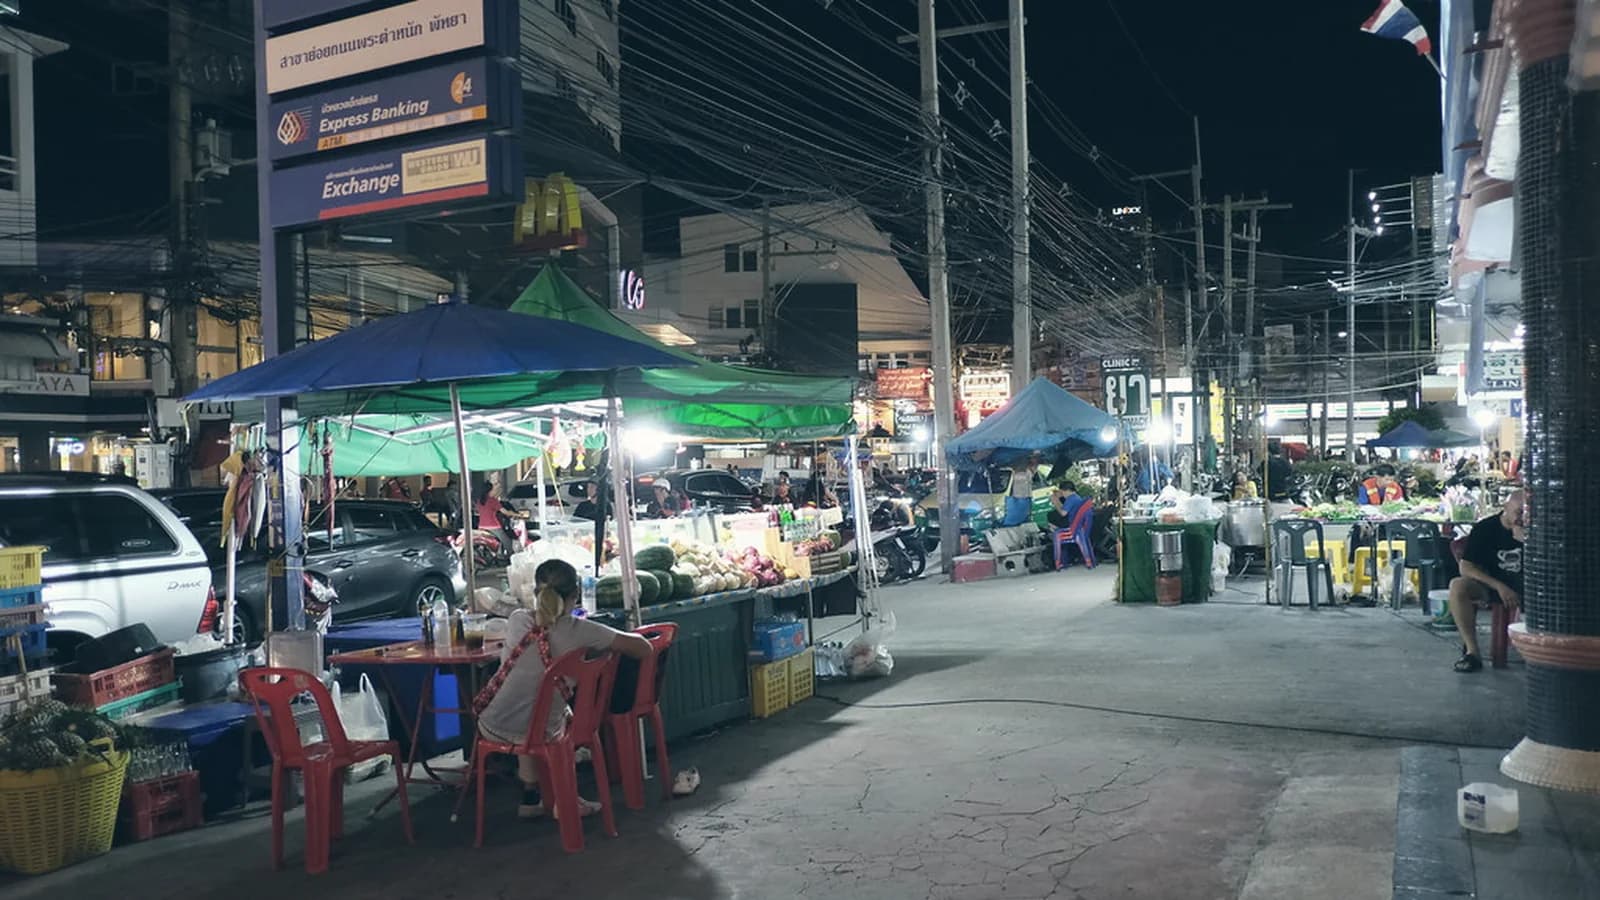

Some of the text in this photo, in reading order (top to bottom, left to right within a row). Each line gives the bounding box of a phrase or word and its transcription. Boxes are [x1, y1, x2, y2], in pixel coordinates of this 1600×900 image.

[429, 12, 467, 32] พัทยา
[319, 100, 429, 133] Express Banking
[322, 135, 343, 148] ATM
[322, 173, 400, 199] Exchange
[1102, 358, 1130, 368] CLINIC
[1105, 374, 1147, 416] ยา
